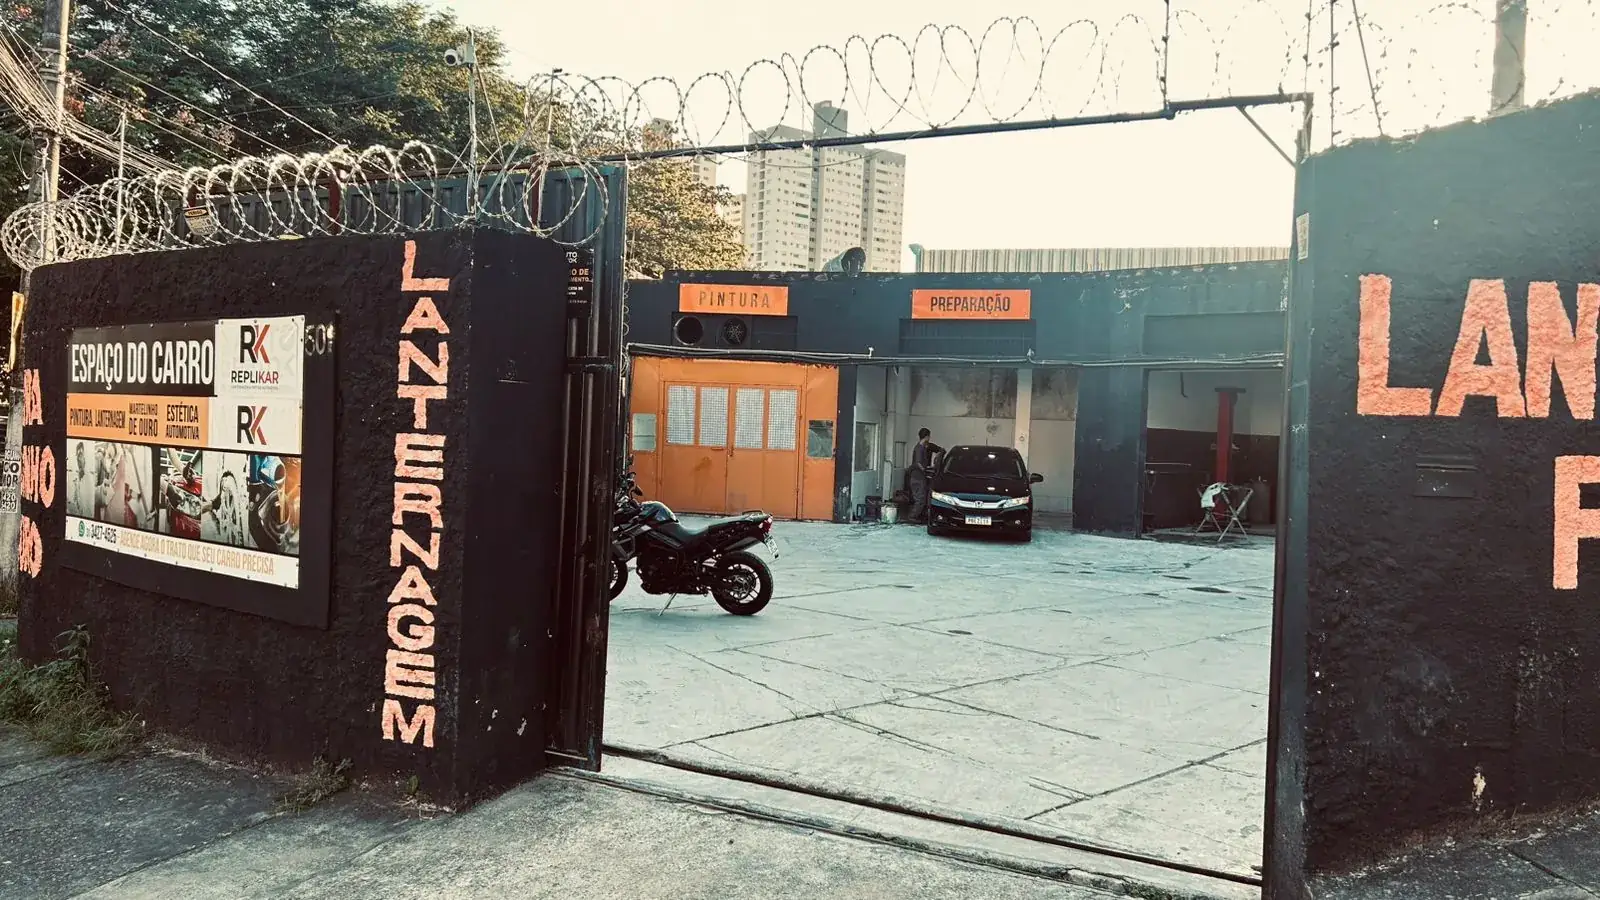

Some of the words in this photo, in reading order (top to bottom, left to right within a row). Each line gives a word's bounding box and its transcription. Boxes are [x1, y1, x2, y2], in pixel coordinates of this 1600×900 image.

[699, 291, 770, 308] PINTURA
[930, 293, 1011, 314] PREPARAÇÃO
[240, 324, 271, 364] RK
[72, 342, 123, 391] ESPAÇO
[127, 341, 147, 384] DO
[152, 339, 214, 385] CARRO
[231, 370, 279, 384] REPLIKAR
[69, 408, 94, 428] PINTURA
[95, 409, 126, 429] LANTERNAGEM
[128, 402, 158, 416] MARTELINHO
[167, 401, 199, 423] ESTÉTICA
[129, 417, 137, 435] DE
[139, 418, 158, 437] OURO
[165, 425, 200, 440] AUTOMOTIVA
[236, 405, 268, 446] RK
[382, 240, 450, 748] LANTERNAGEM
[166, 540, 187, 560] TRATO
[187, 543, 201, 561] QUE
[202, 546, 215, 564] SEU
[217, 548, 241, 569] CARRO
[242, 552, 275, 576] PRECISA
